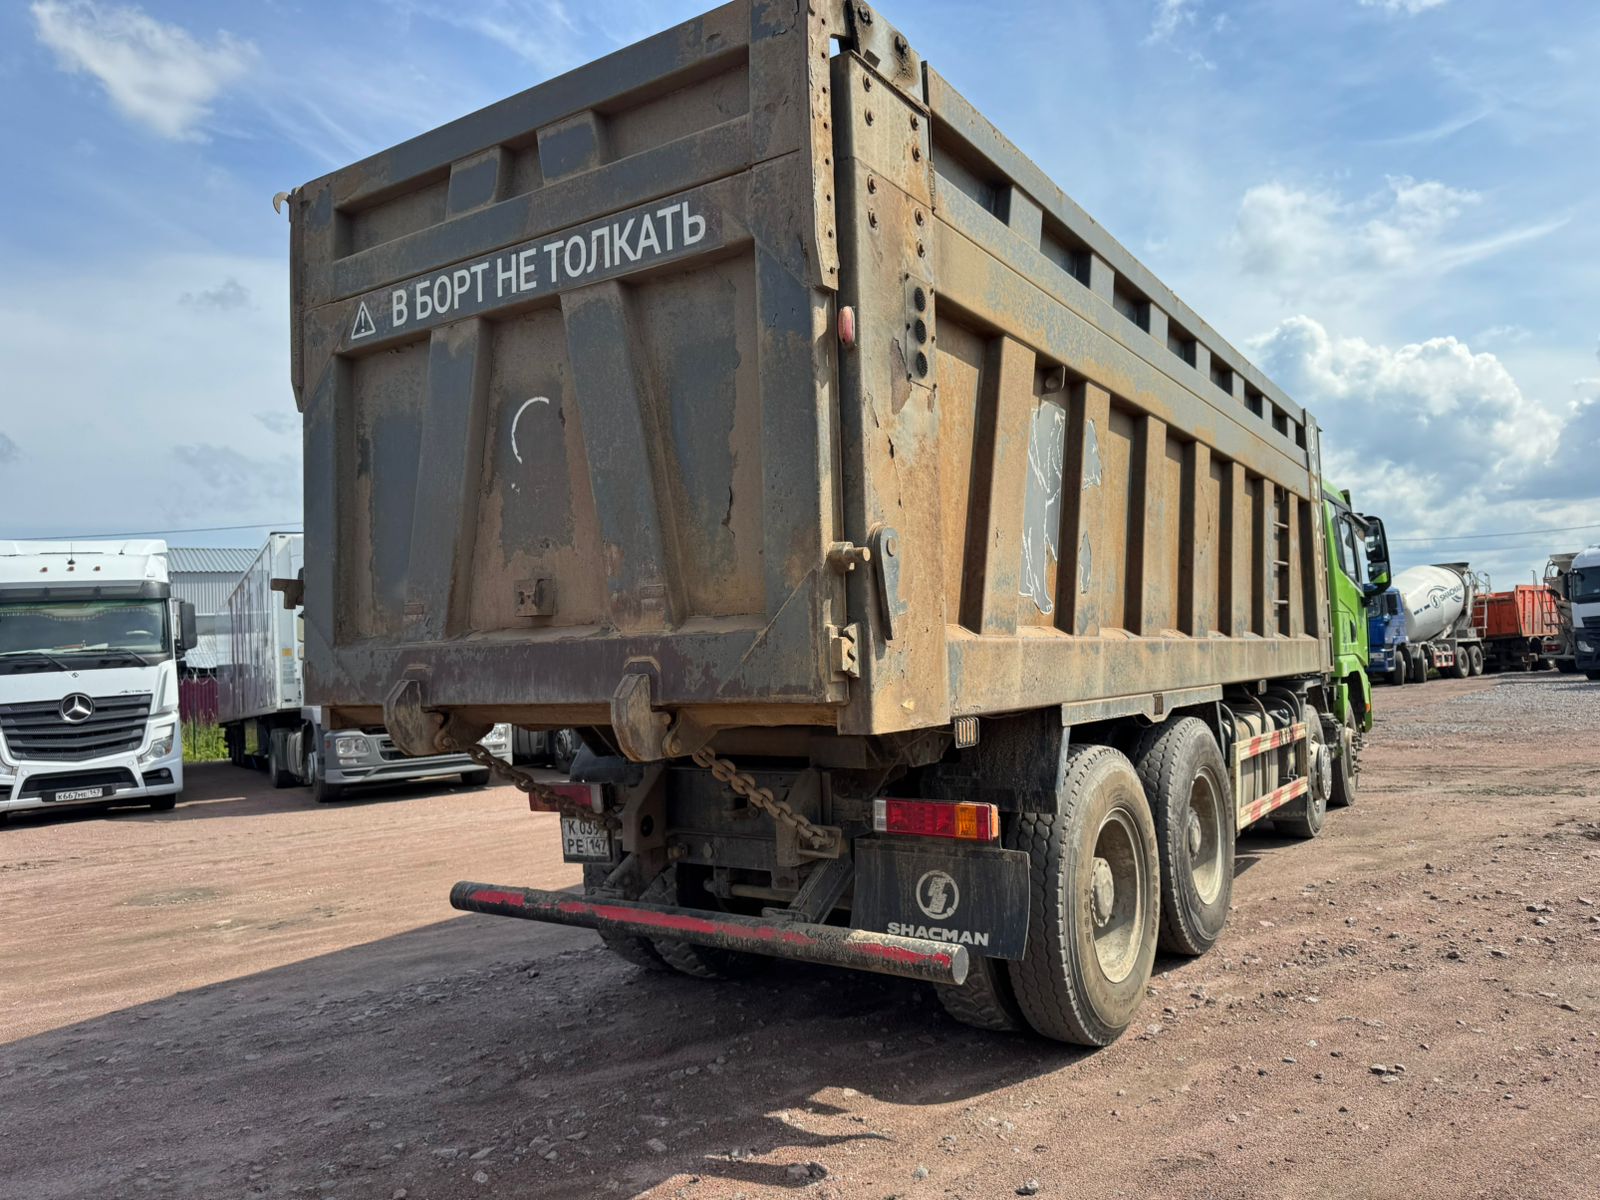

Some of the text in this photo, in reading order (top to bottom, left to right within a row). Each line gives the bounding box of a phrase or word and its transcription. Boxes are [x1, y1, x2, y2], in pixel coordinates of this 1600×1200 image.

[392, 201, 706, 327] В БОРТ НЕ ТОЛКАТЬ
[887, 922, 989, 946] SHACMAN
